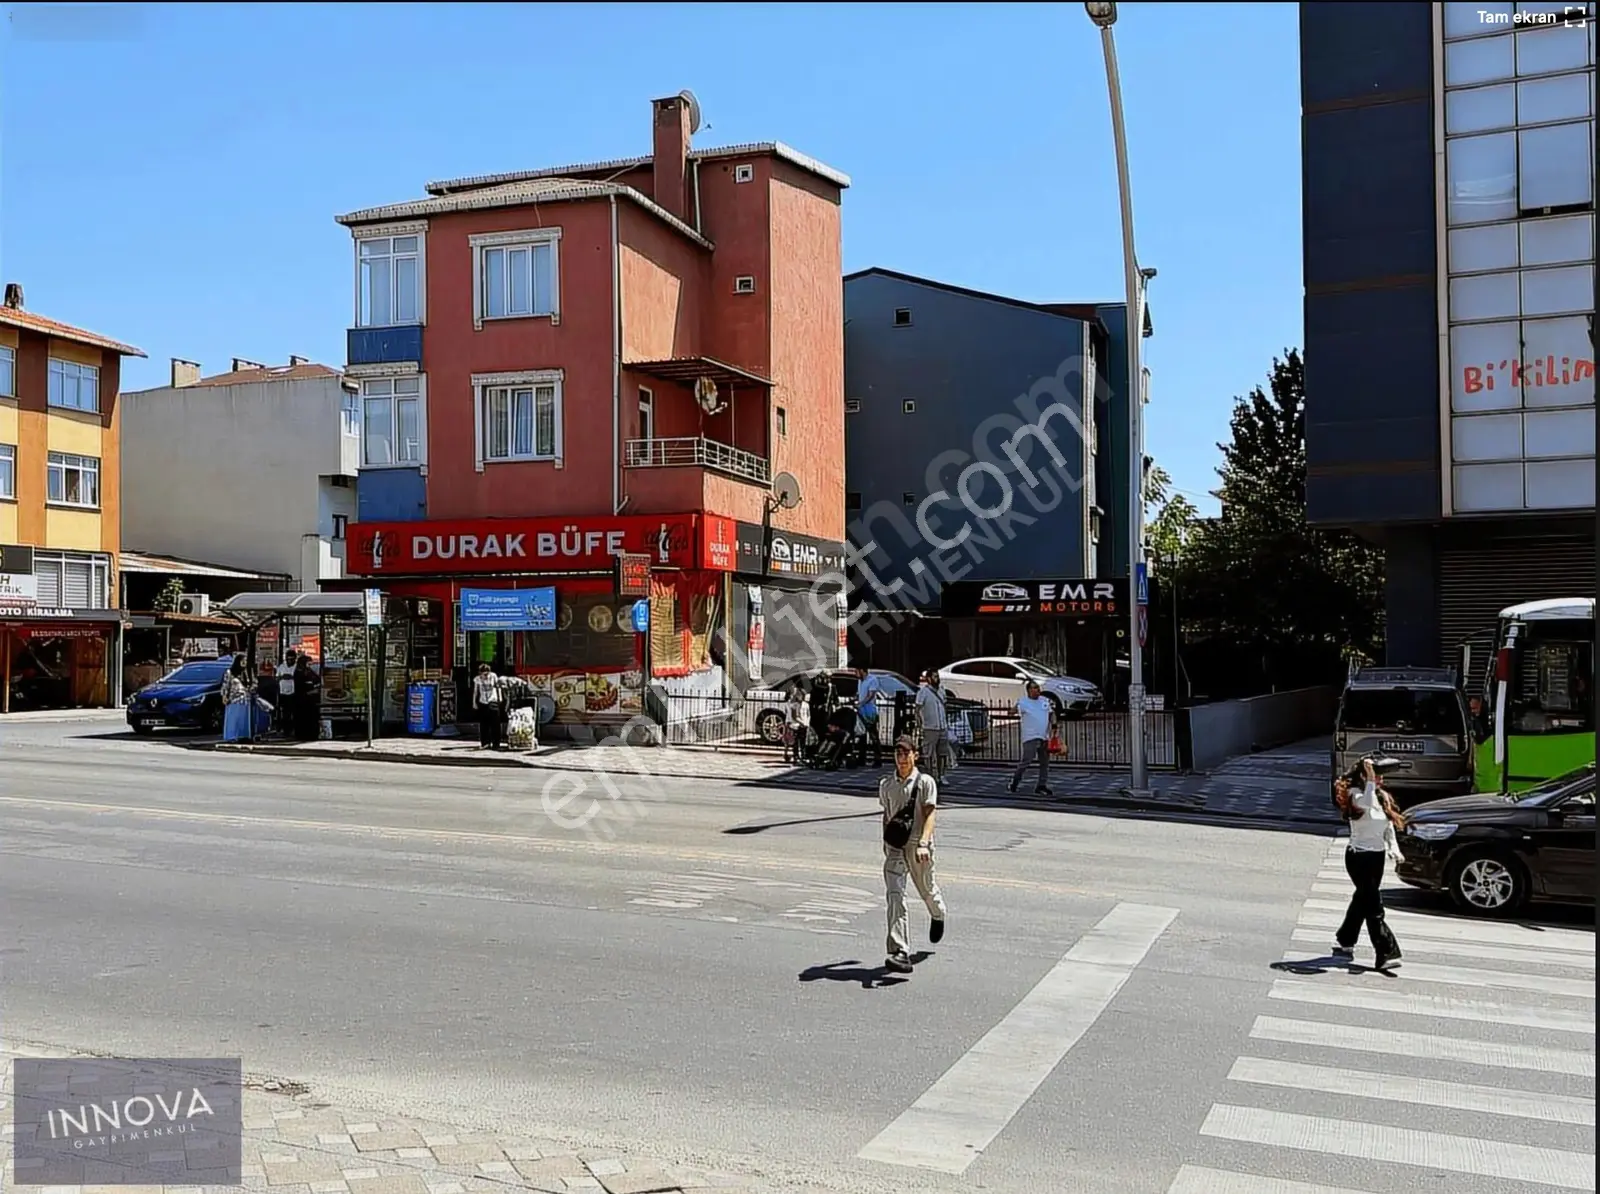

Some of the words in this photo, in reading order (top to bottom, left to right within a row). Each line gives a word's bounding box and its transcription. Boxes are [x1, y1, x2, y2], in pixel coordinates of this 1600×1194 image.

[412, 533, 527, 559] DURAK
[537, 525, 626, 557] BÜFE
[792, 543, 818, 565] EMR
[1038, 583, 1115, 600] EMR
[0, 608, 22, 617] OTO
[26, 607, 75, 617] KİRALAMA
[1039, 602, 1116, 612] MOTORS
